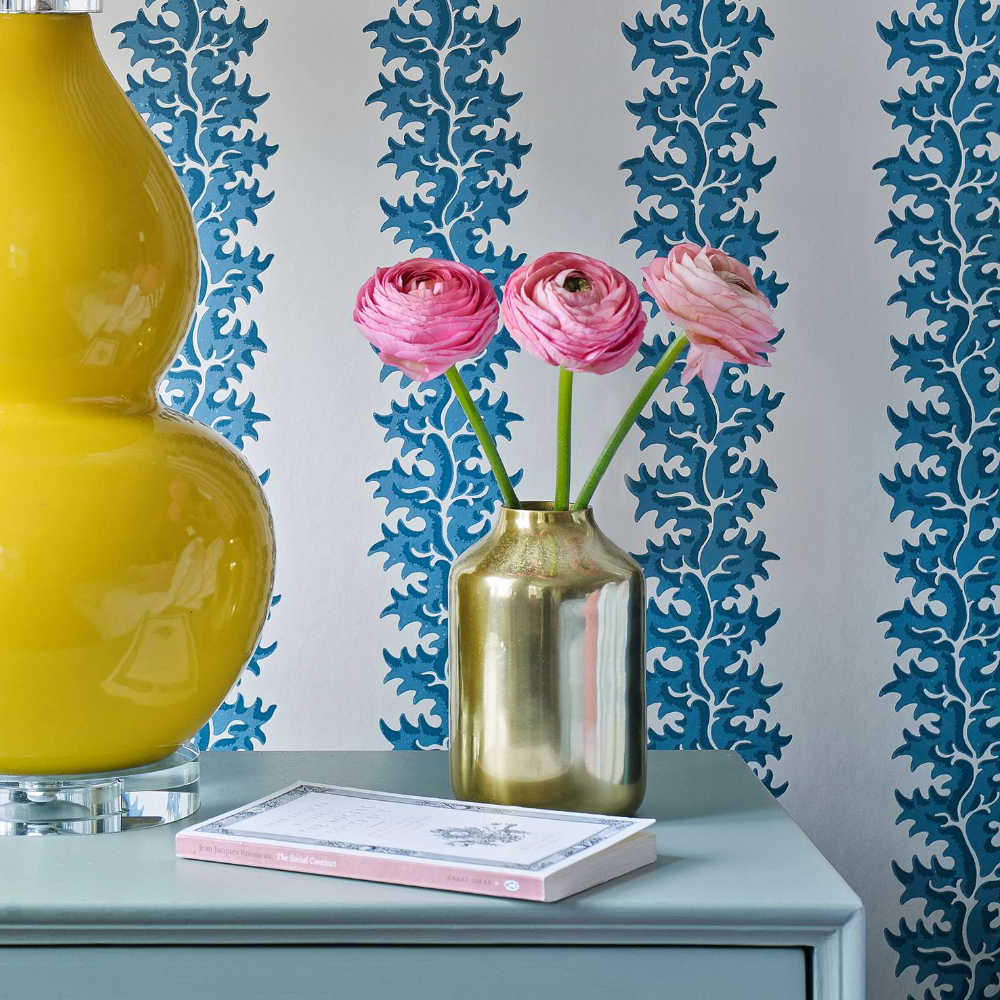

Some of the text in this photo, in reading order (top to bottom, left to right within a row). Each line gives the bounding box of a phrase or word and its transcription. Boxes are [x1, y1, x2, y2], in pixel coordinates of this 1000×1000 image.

[197, 844, 337, 868] Jean Jacques Rousseau The Social Contract
